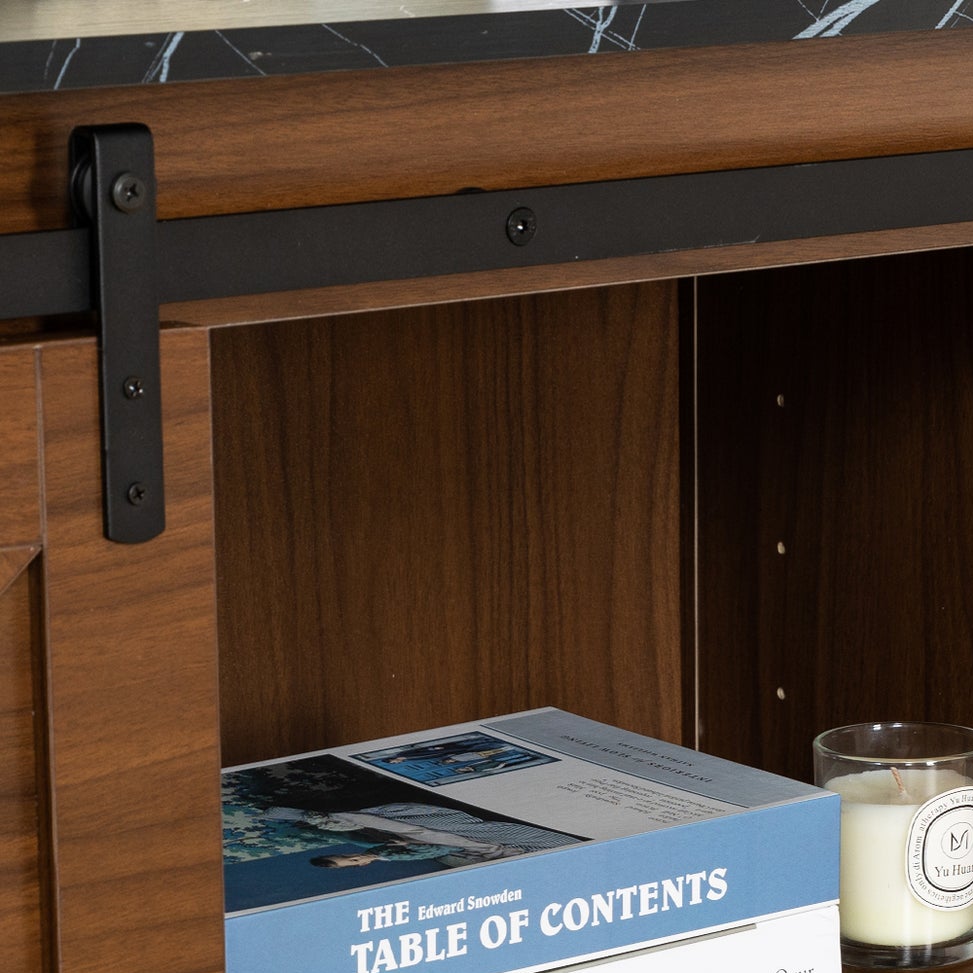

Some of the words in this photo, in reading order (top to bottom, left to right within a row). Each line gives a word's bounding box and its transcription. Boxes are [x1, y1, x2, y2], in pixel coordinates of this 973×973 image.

[935, 865, 949, 878] Yu
[358, 900, 410, 933] THE
[418, 897, 465, 921] Edward
[467, 888, 522, 911] Snowden
[479, 909, 530, 949] OF
[539, 867, 729, 937] CONTENTS
